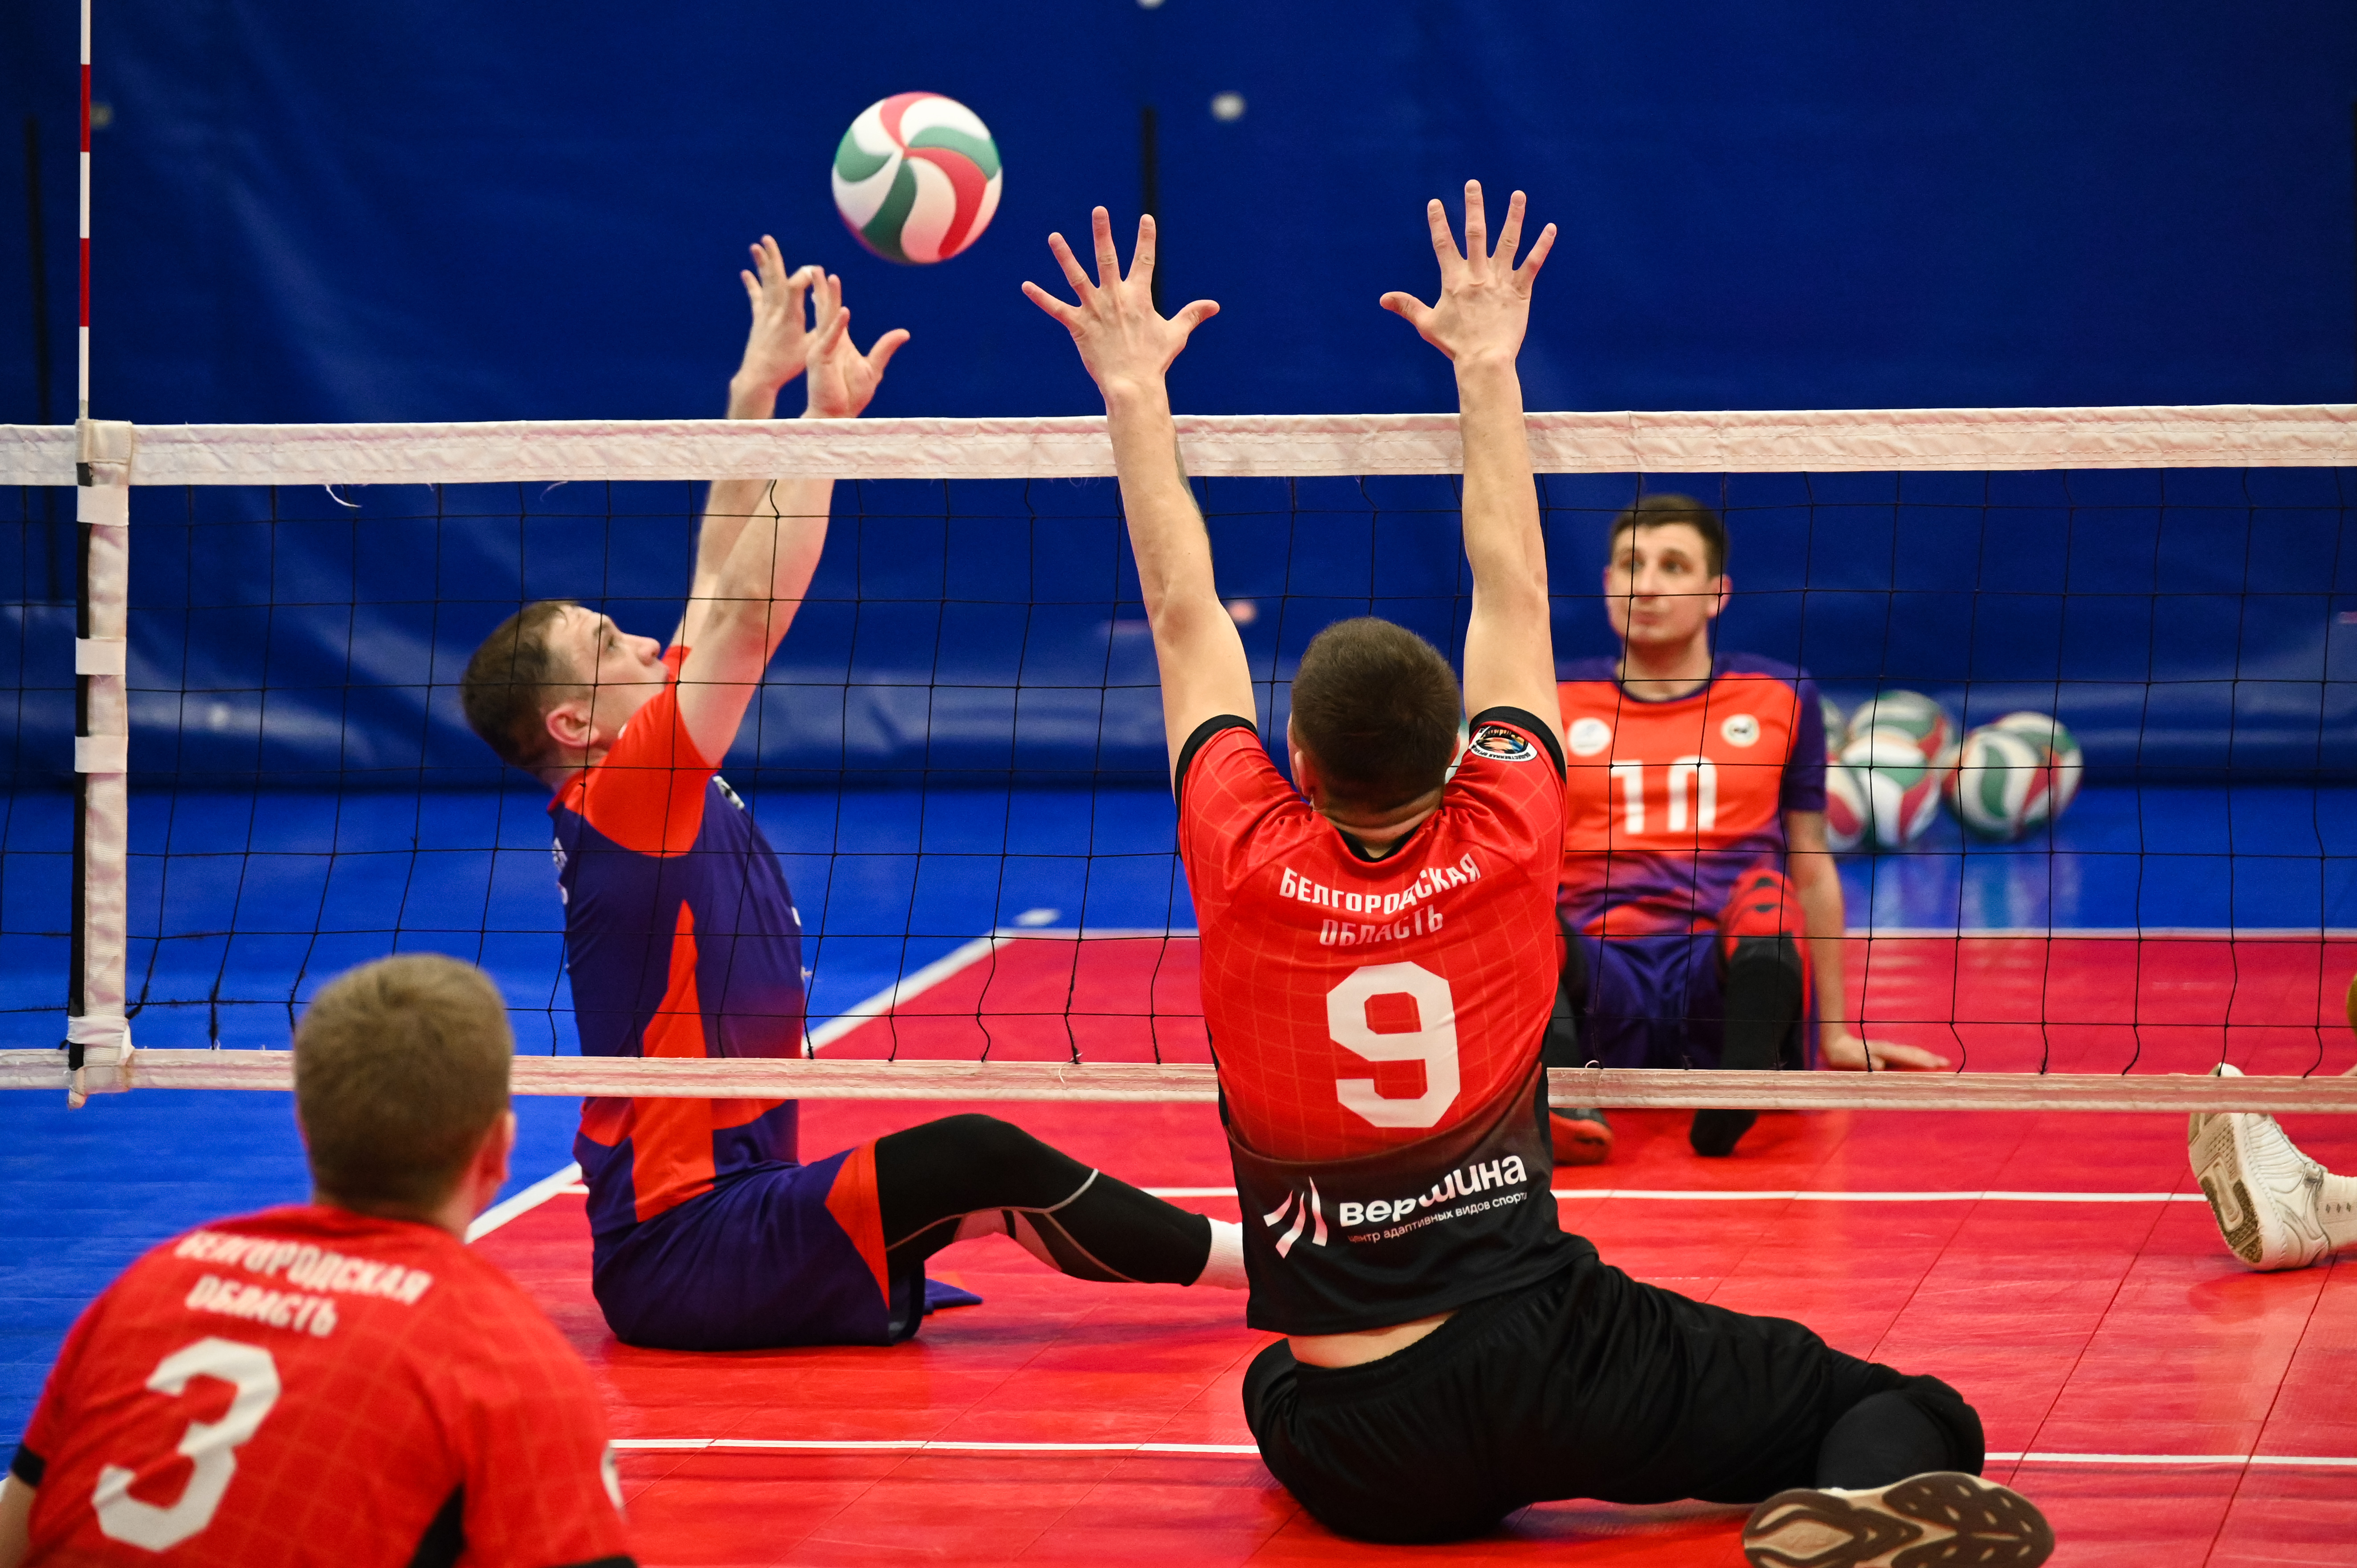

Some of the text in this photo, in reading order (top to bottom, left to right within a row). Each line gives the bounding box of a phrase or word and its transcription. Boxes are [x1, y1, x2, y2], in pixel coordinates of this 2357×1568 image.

[1609, 755, 1718, 834] 10
[1279, 853, 1481, 914] БЕЛГОРОДСКАЯ
[1319, 904, 1443, 946] ОБЛАСТЬ
[1326, 961, 1461, 1128] 9
[1383, 1210, 1454, 1239] адаптивных
[1456, 1201, 1491, 1217] видов
[185, 1274, 337, 1337] ОБЛАСТЬ
[92, 1338, 282, 1553] 3
